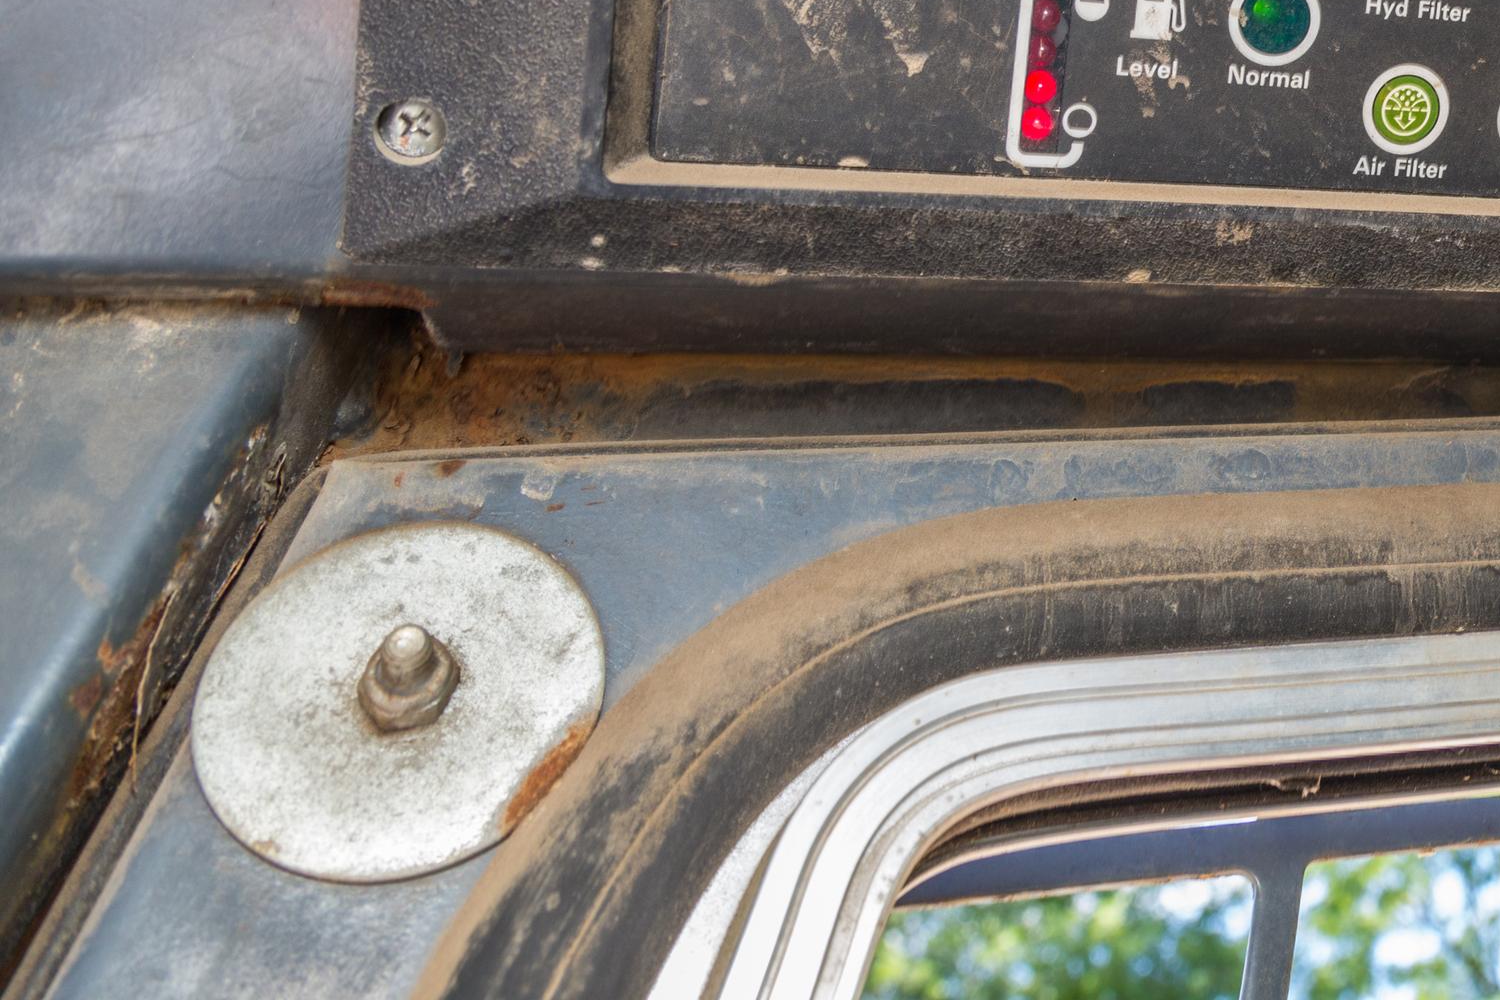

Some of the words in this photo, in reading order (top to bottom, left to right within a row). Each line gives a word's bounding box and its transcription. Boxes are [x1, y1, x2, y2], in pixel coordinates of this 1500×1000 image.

[1417, 0, 1471, 23] Filter
[1116, 54, 1178, 80] Level
[1227, 64, 1311, 90] Normal
[1352, 155, 1385, 176] Air
[1394, 158, 1448, 179] Filter
